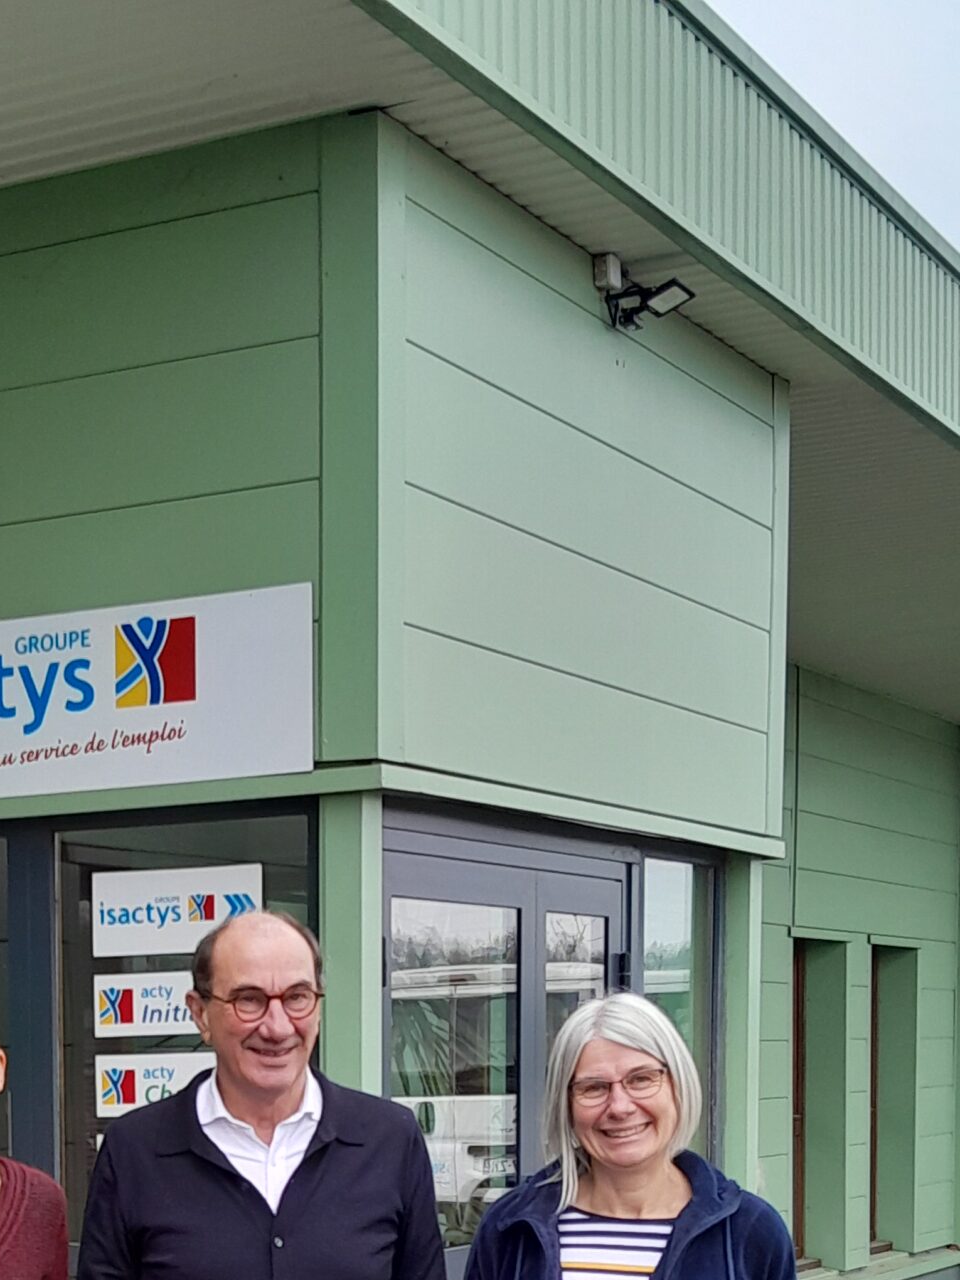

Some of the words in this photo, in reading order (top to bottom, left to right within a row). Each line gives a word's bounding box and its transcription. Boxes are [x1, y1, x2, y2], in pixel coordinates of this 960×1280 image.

[15, 628, 91, 655] GROUPE
[19, 739, 81, 766] service
[84, 731, 109, 754] de
[111, 719, 187, 755] l'emploi
[99, 901, 182, 930] isactys
[140, 985, 173, 1001] acty
[141, 1003, 195, 1024] Initi
[143, 1066, 176, 1082] acty
[145, 1083, 173, 1105] Ch
